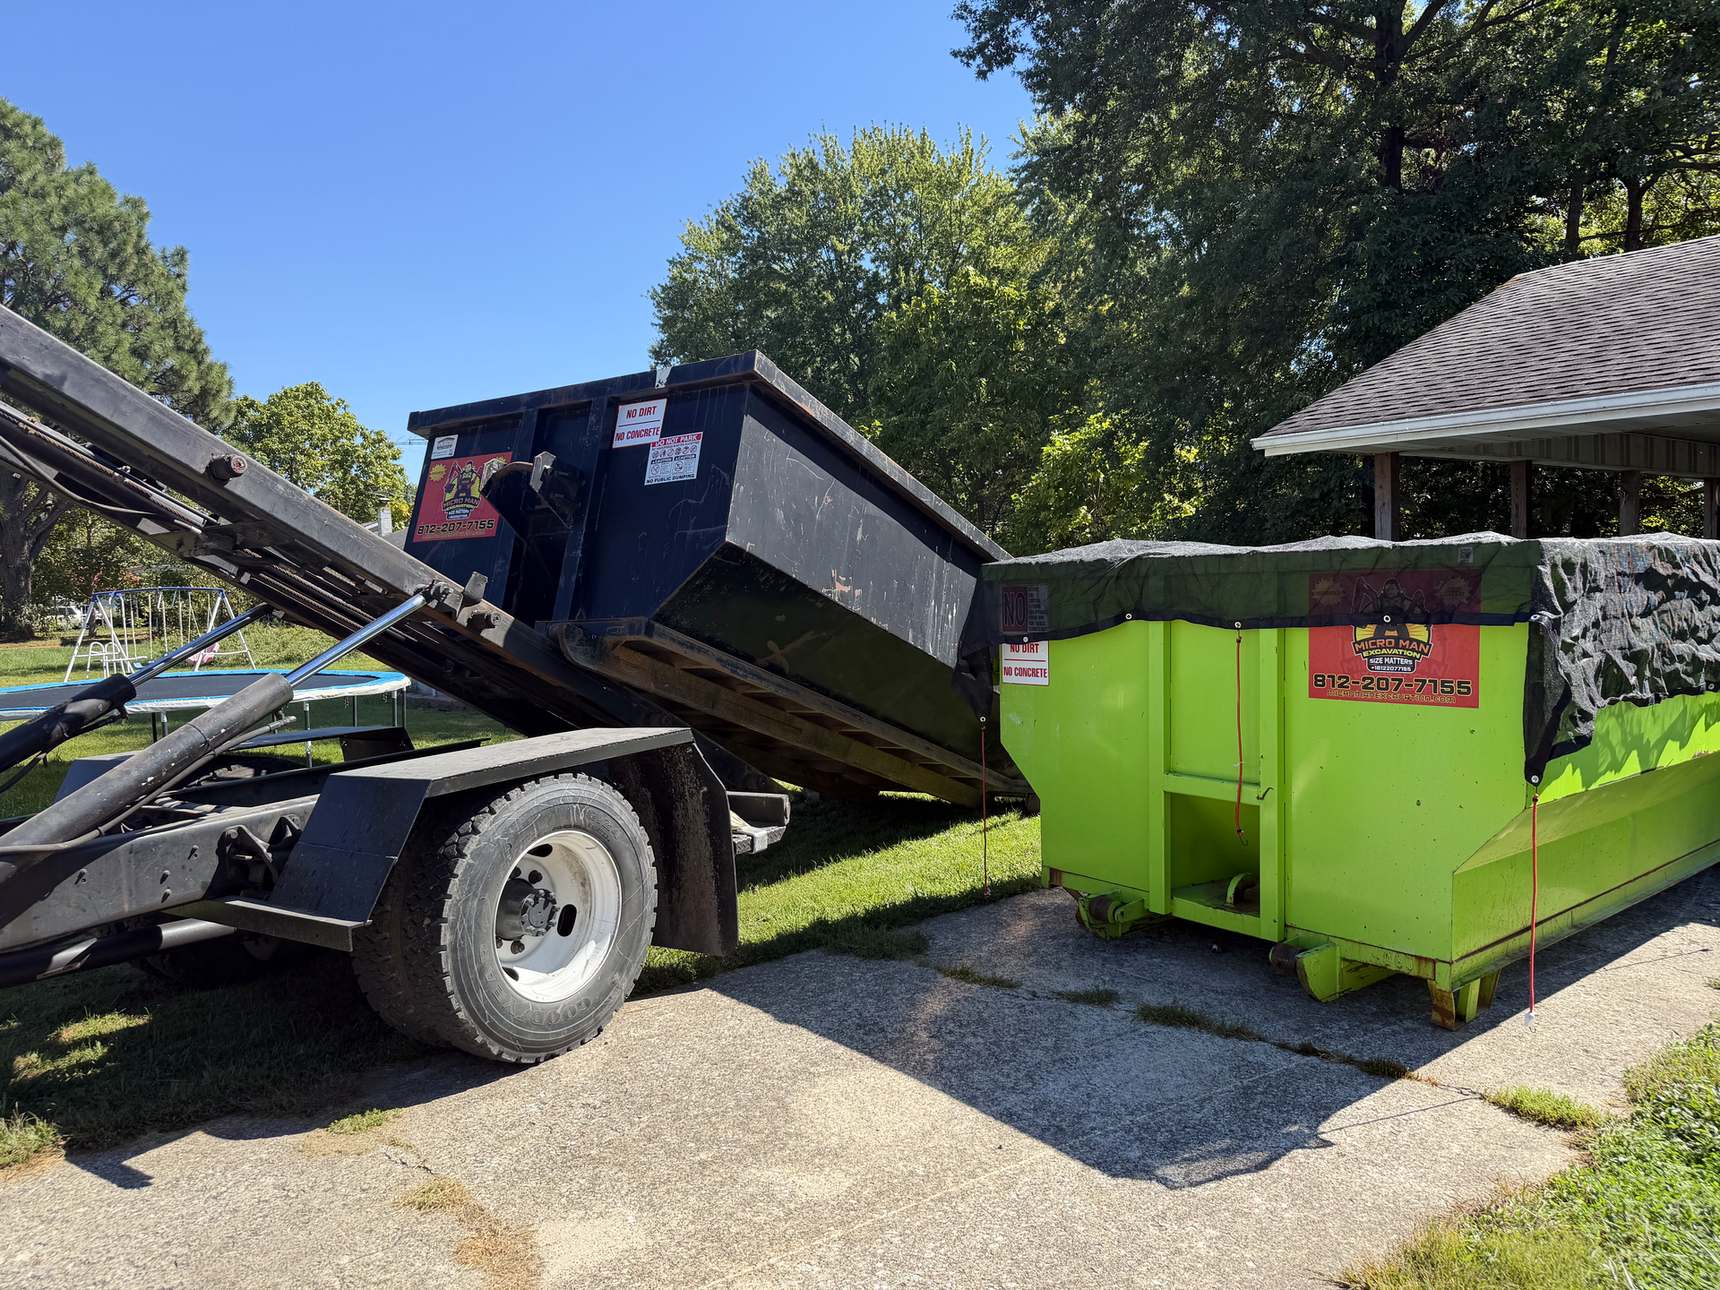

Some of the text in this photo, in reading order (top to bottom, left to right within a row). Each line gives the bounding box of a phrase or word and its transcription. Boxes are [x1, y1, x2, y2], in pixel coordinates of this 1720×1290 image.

[626, 406, 657, 419] NO DIRT
[615, 427, 660, 441] NO CONCRETE
[417, 519, 495, 535] 812-207-7155
[1022, 643, 1039, 653] DIRT
[1355, 639, 1429, 654] MICRO MAN
[1363, 648, 1421, 658] EXCAVATION
[1384, 657, 1412, 665] MATTERS
[1003, 666, 1047, 678] NO CONCRETE
[1312, 673, 1472, 696] 812-207-7155
